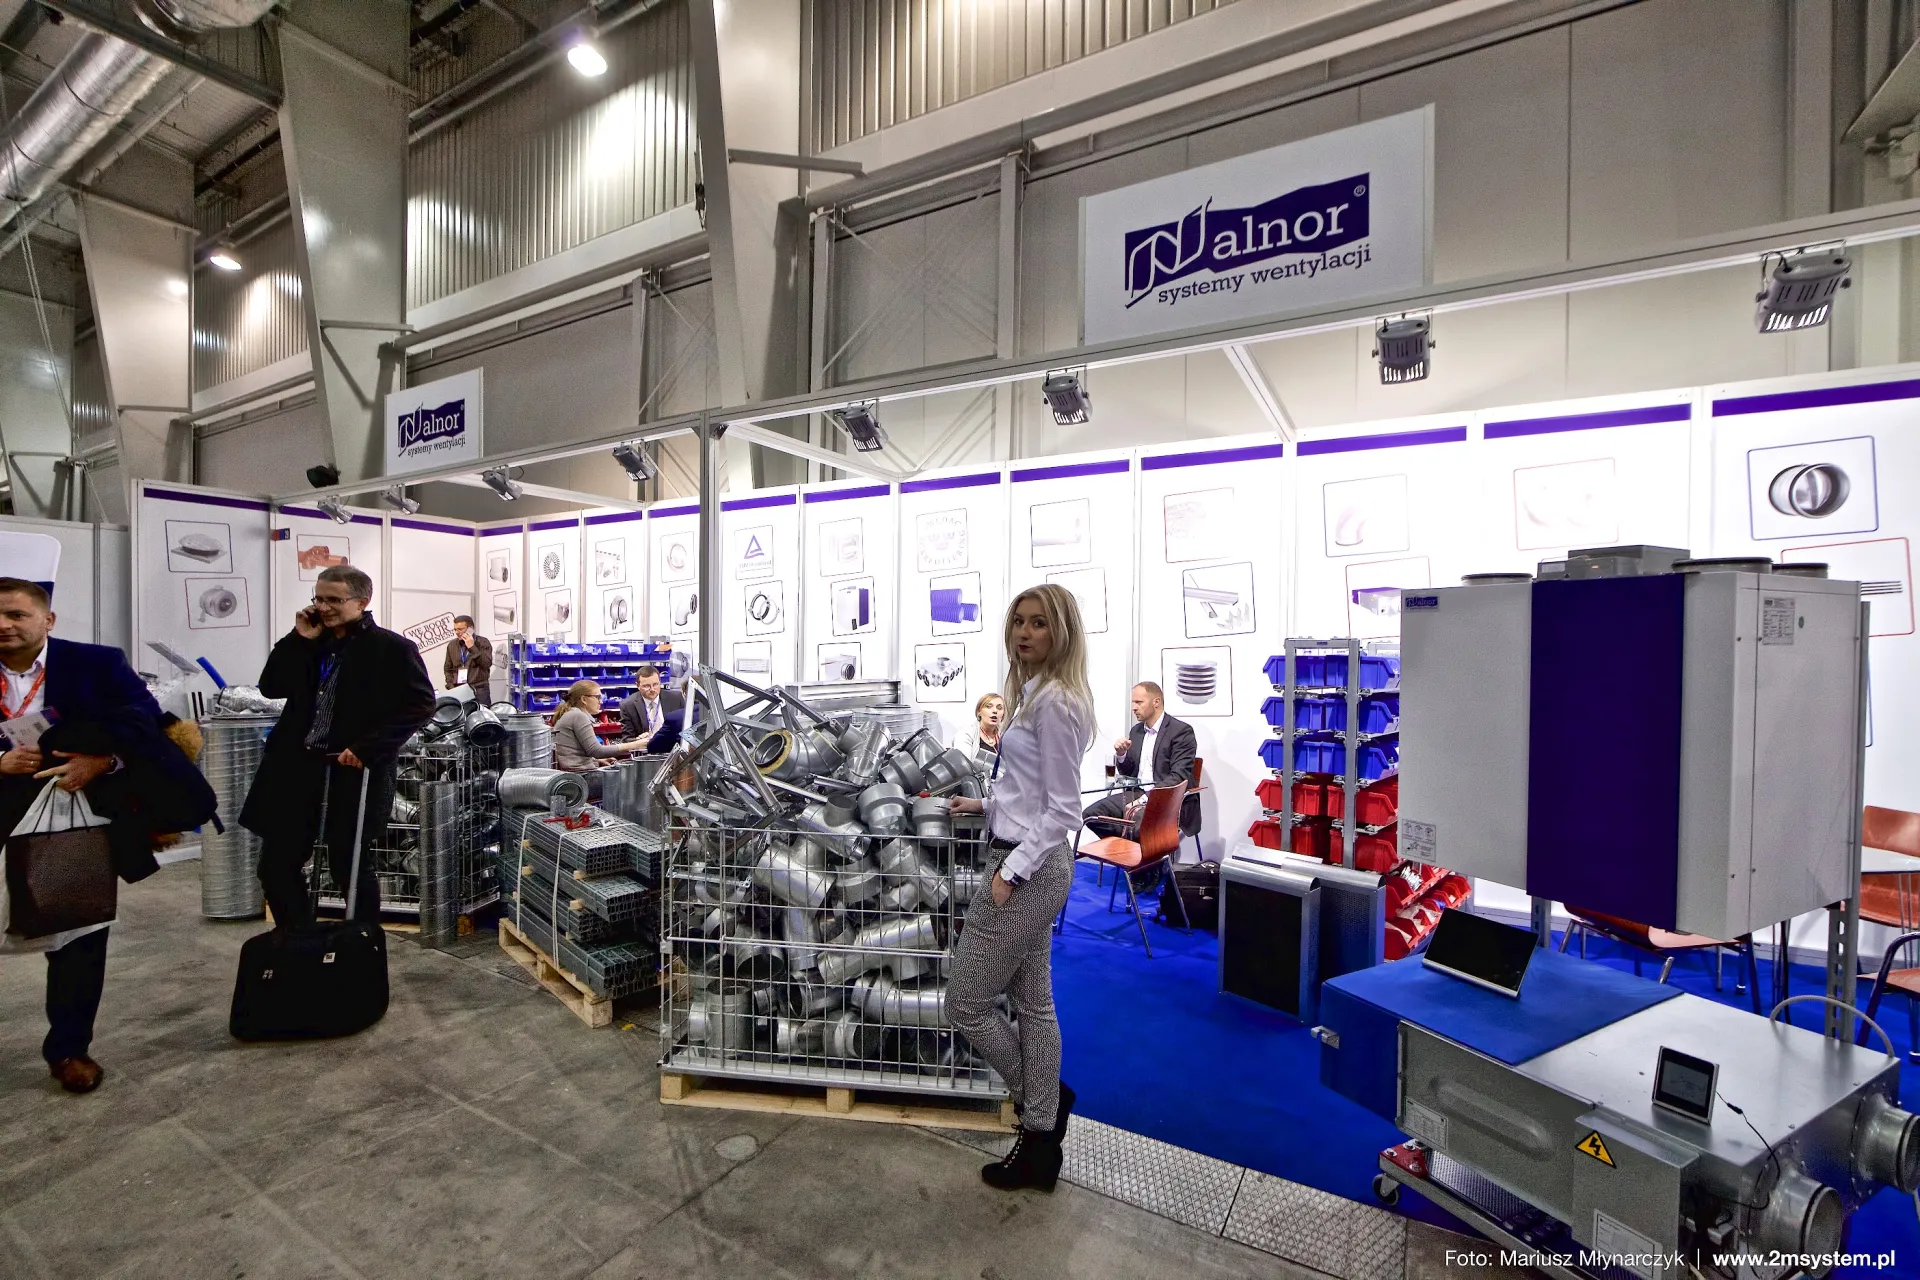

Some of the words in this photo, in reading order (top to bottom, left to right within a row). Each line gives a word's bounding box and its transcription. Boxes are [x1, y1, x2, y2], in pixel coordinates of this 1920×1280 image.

[1158, 273, 1245, 305] systemy
[1250, 243, 1372, 282] wentylacji
[407, 444, 433, 457] systemy
[433, 434, 466, 451] wentylacji
[408, 627, 422, 638] WE
[415, 623, 451, 645] YOUR
[417, 629, 455, 650] BUSINESS
